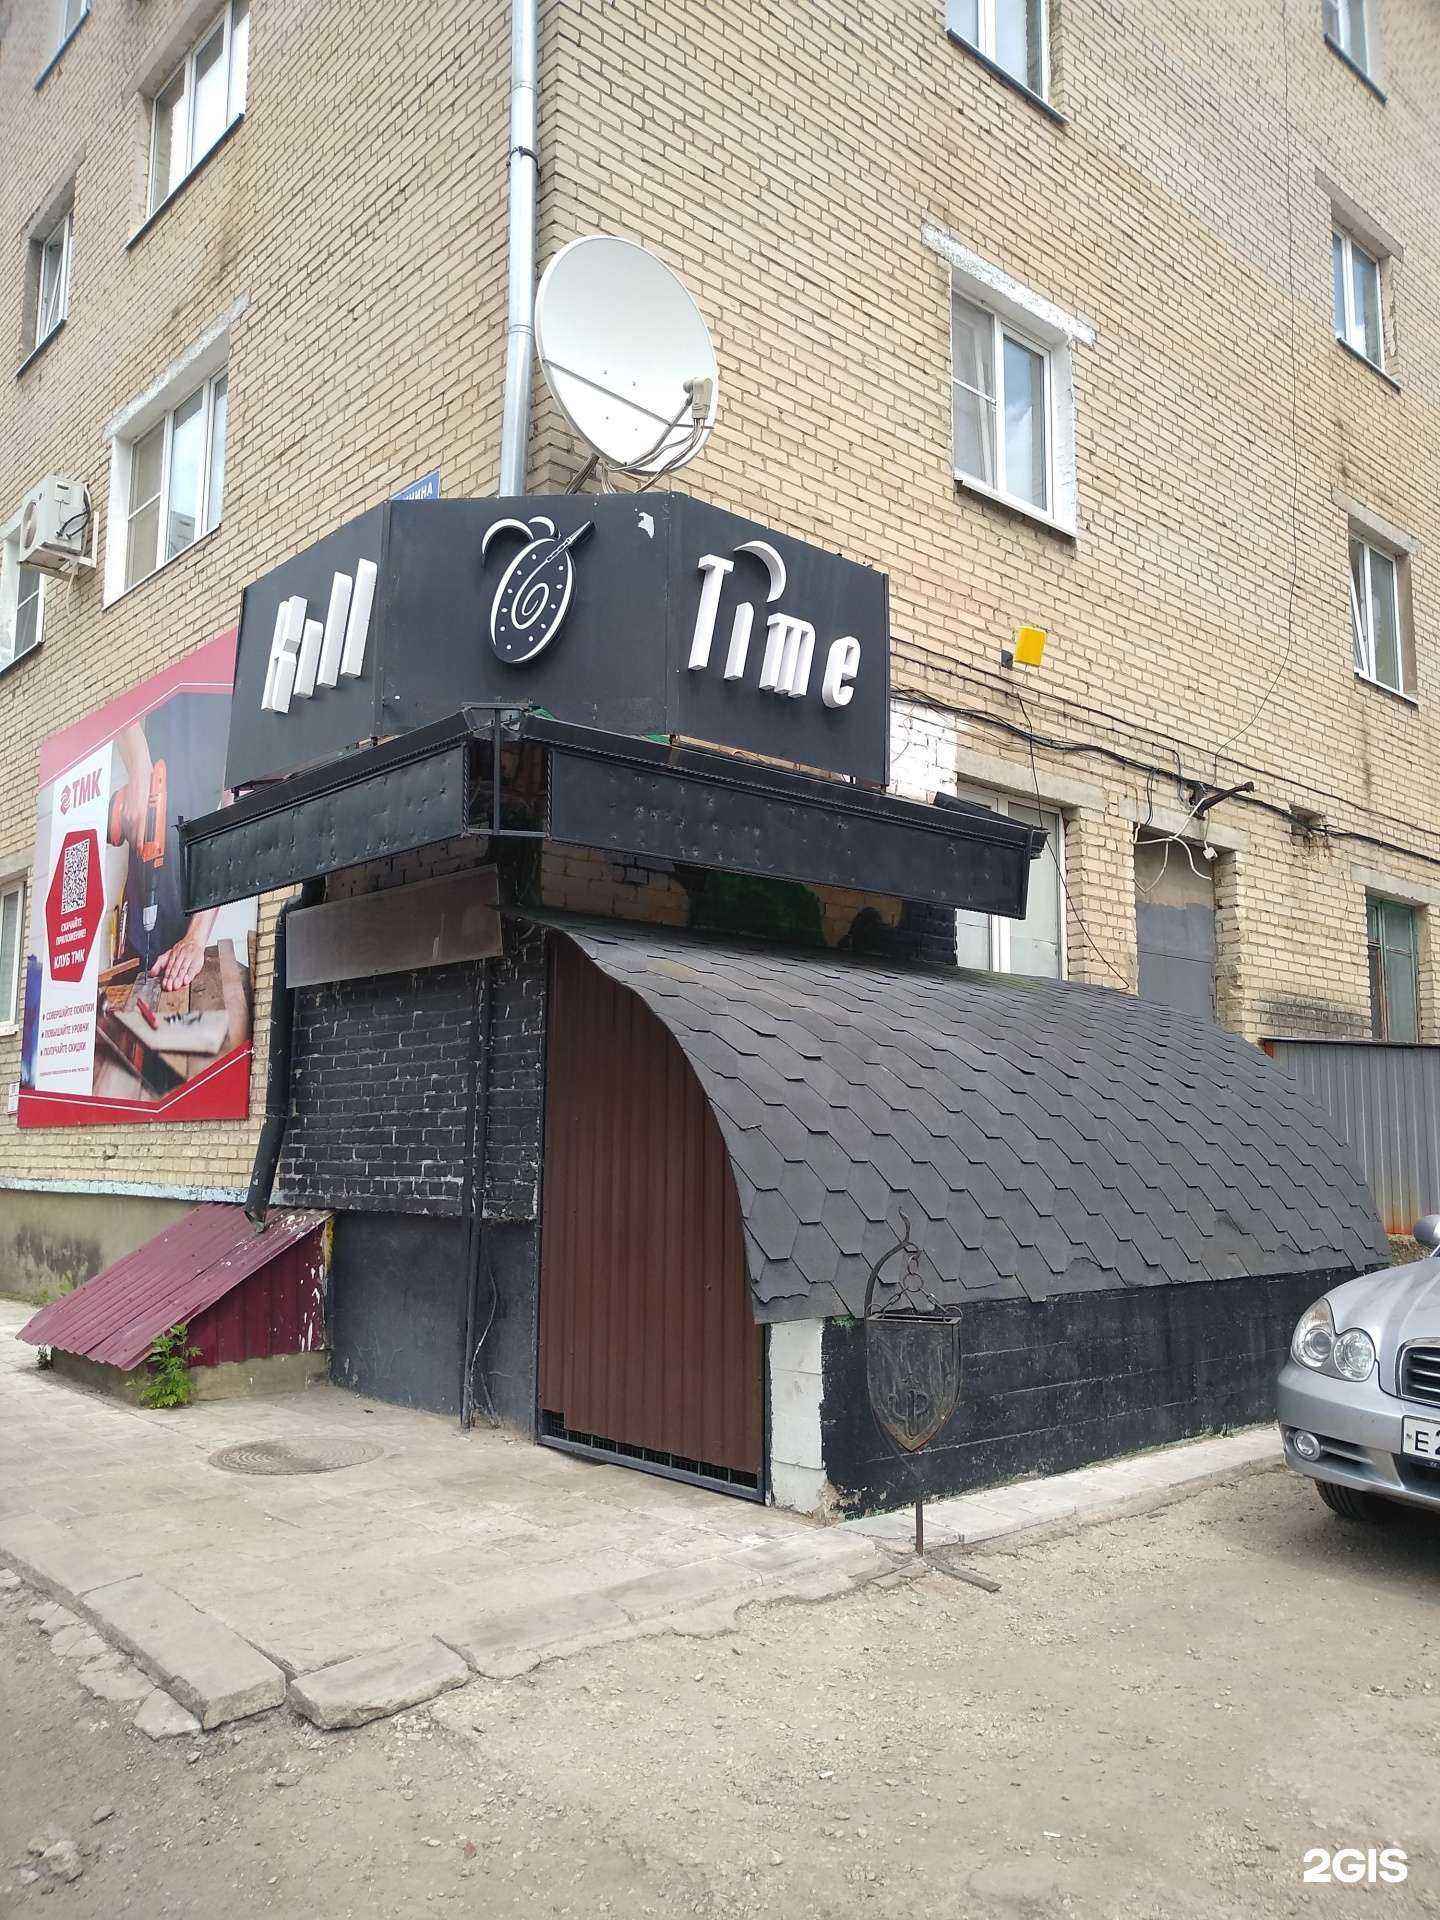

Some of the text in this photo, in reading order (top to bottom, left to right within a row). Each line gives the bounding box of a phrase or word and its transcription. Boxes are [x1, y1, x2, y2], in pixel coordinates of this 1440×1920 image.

[688, 541, 861, 708] Time
[72, 768, 102, 808] ТМК
[54, 948, 86, 969] КЛУБ ТМК
[46, 1002, 95, 1020] СОВЕРШАЙТЕ ПОКУПКИ
[44, 1024, 71, 1038] ПОВЫШАЙТЕ
[43, 1043, 68, 1056] ПОЛУЧАЙТЕ
